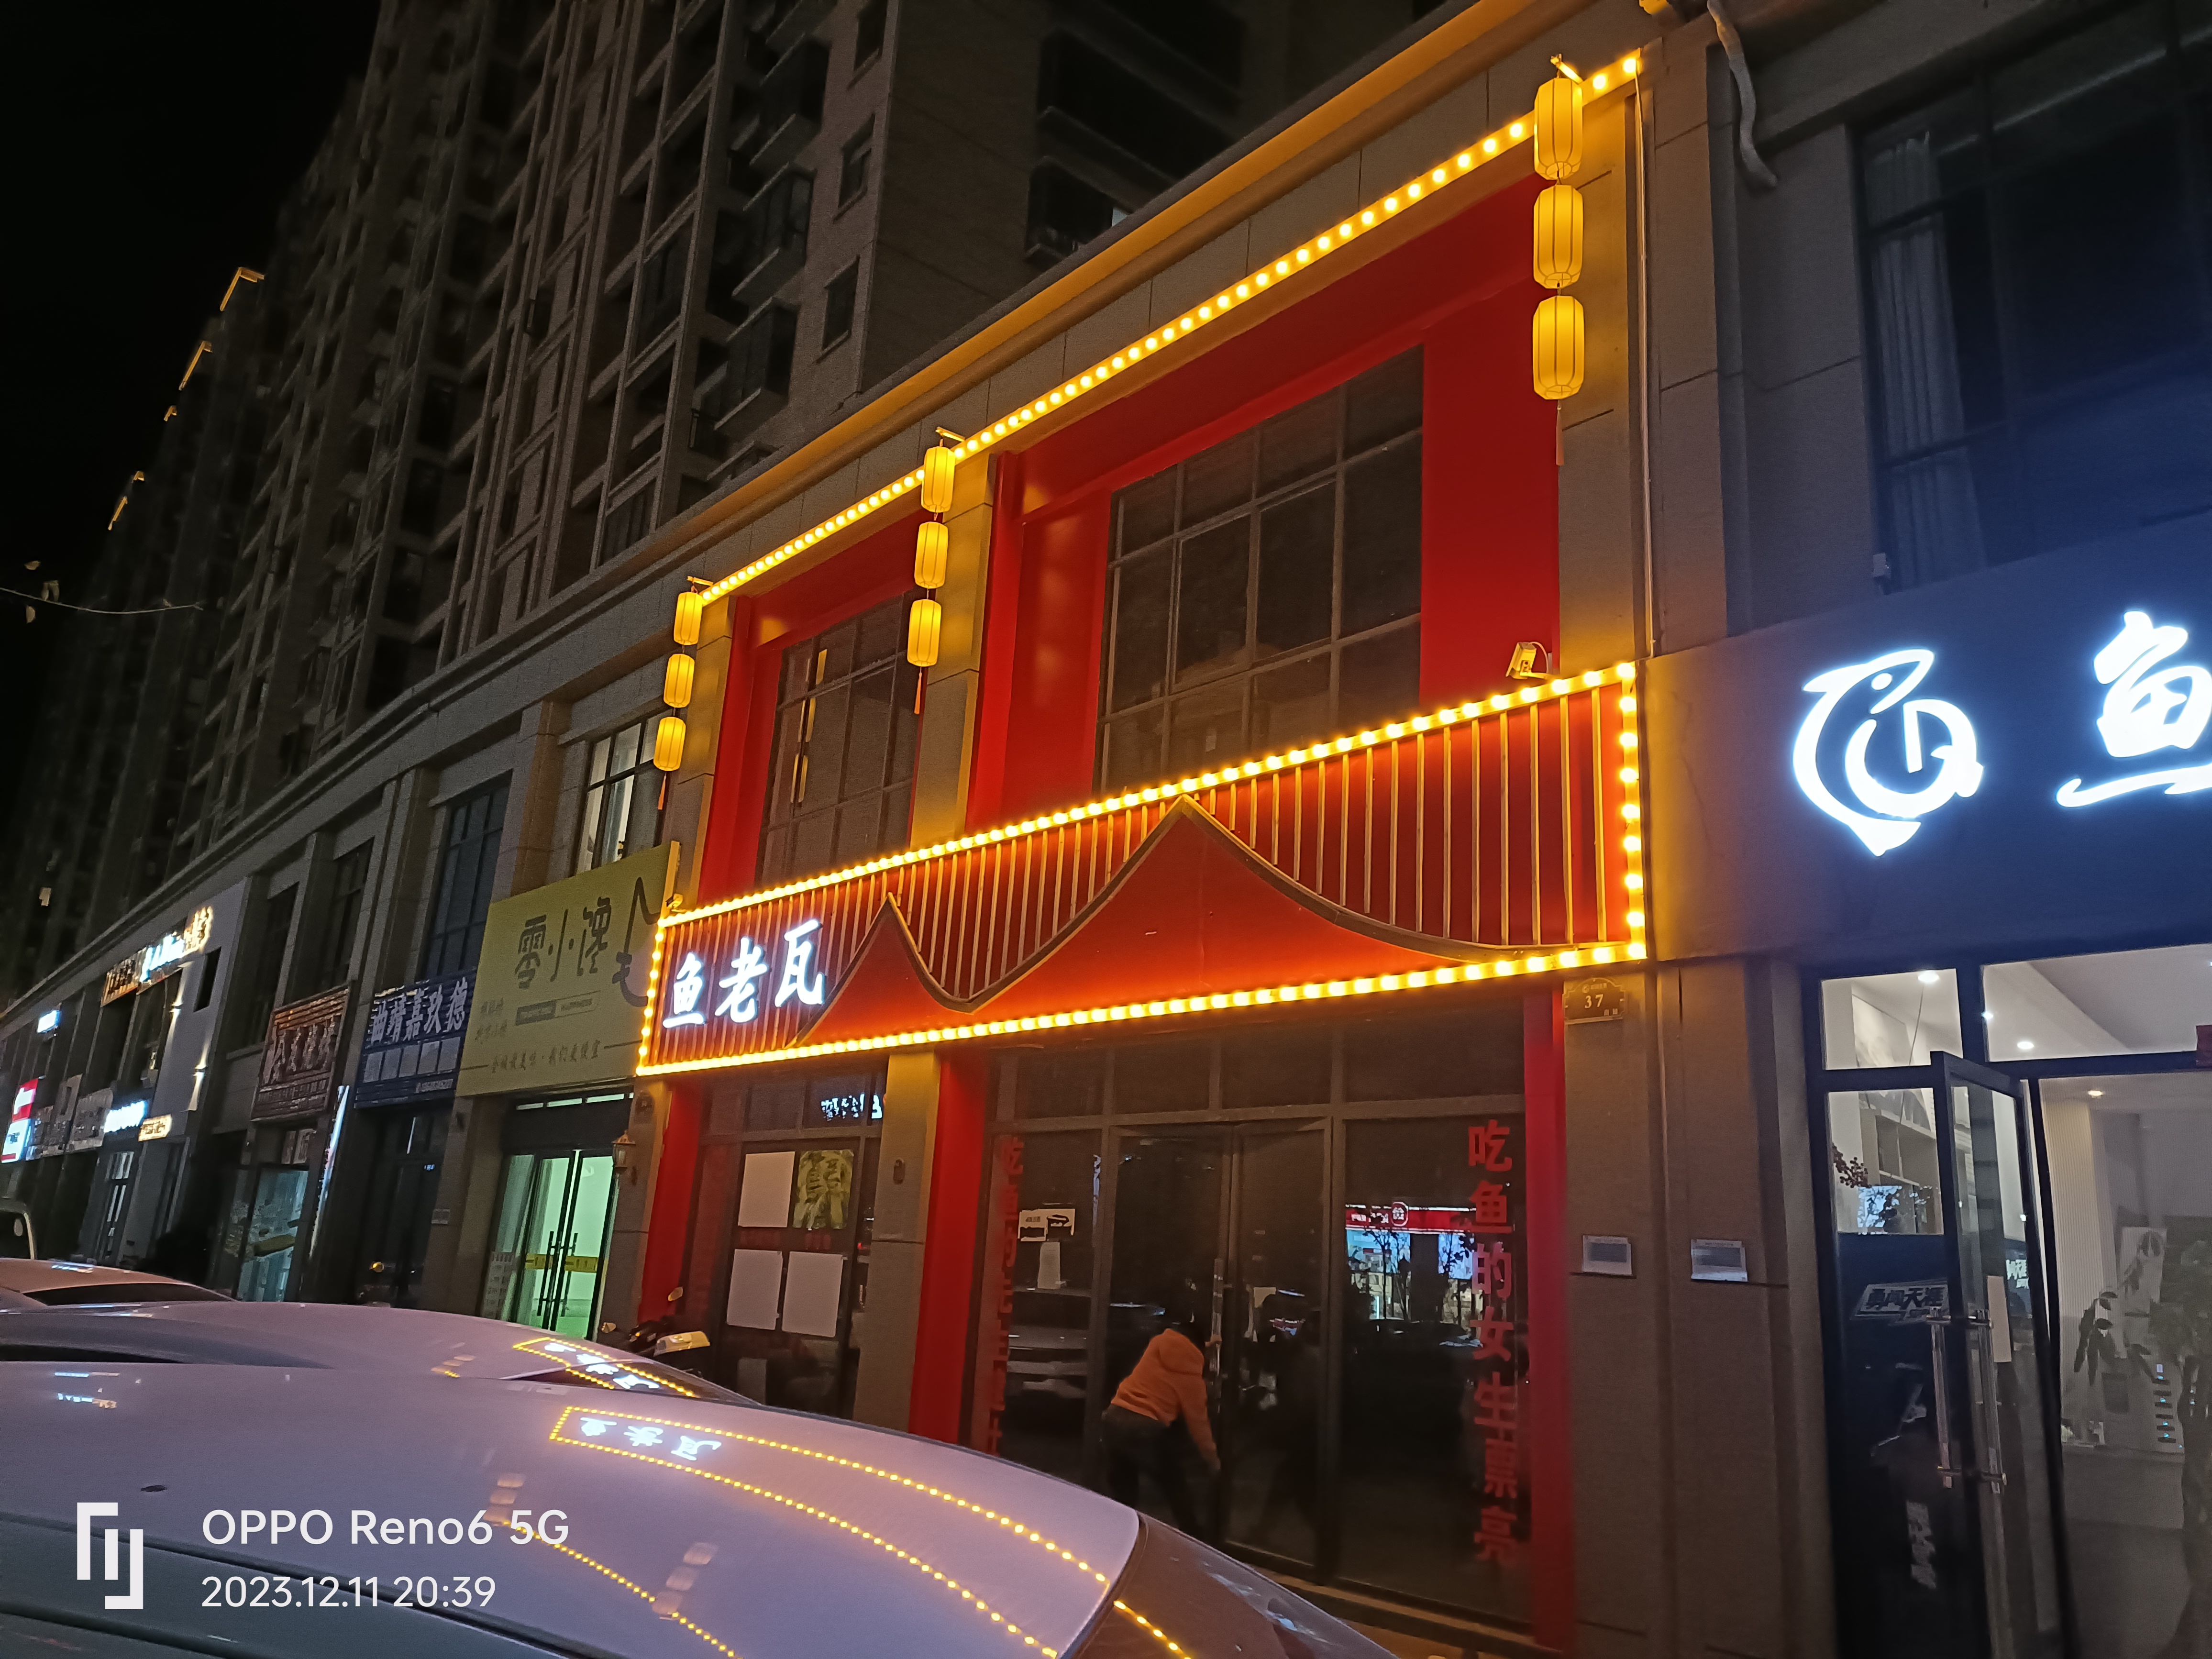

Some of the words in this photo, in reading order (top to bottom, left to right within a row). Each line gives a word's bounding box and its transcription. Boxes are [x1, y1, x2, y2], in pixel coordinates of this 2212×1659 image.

[2056, 610, 2212, 807] 鱼
[663, 919, 825, 1029] 鱼老瓦
[1584, 994, 1604, 1008] 37
